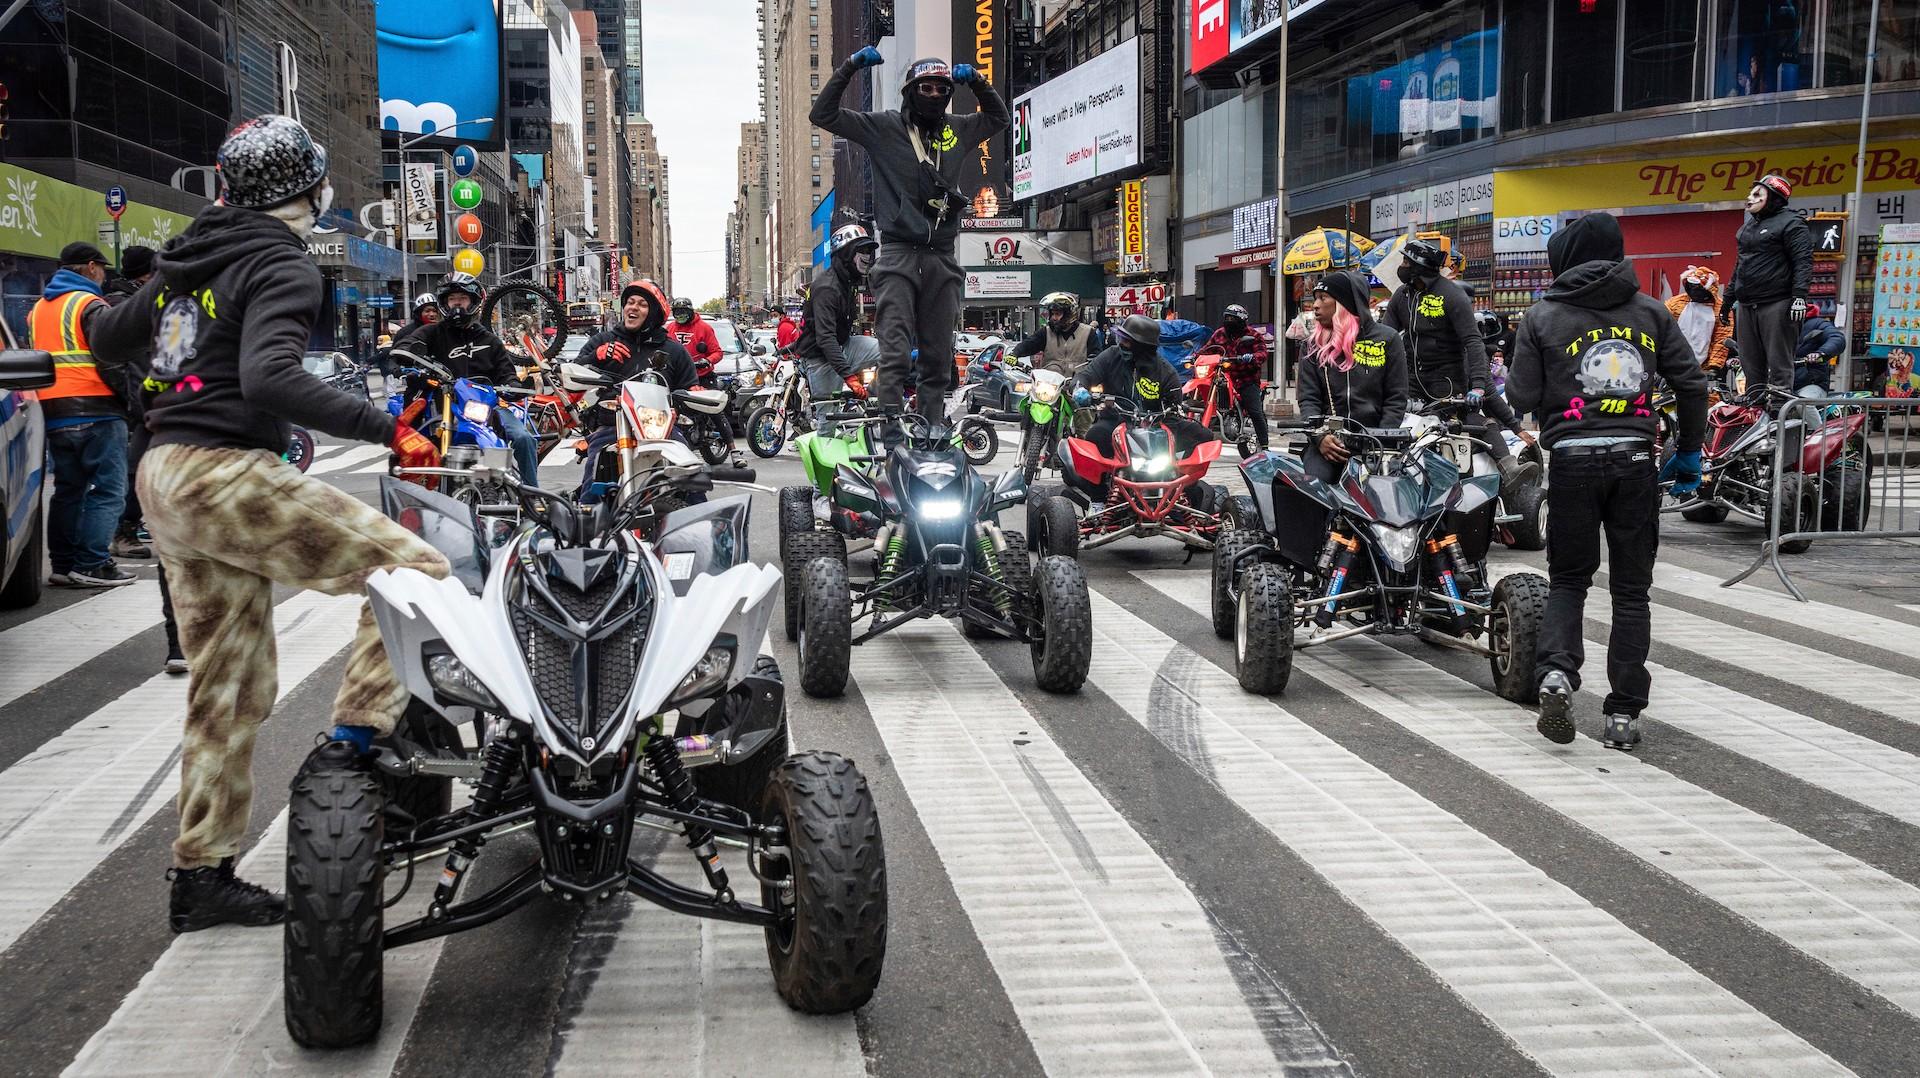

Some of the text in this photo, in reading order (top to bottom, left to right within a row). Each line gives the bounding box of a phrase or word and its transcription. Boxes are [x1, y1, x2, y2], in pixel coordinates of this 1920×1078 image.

[1042, 83, 1125, 128] News with a New Perspective.
[456, 156, 466, 166] m
[1014, 155, 1032, 173] BLACK
[1066, 146, 1093, 165] Listen Now
[1638, 164, 1707, 202] The
[460, 188, 472, 199] m
[1433, 190, 1454, 209] BAGS
[1461, 182, 1493, 203] BOLSAS
[1127, 183, 1140, 253] LUGGAGE
[1376, 203, 1394, 220] BAGS
[467, 223, 478, 233] m
[1499, 219, 1552, 237] BAGS
[461, 258, 474, 268] m
[1253, 249, 1277, 260] CHOCOLATE
[1126, 264, 1141, 273] NY
[1285, 259, 1329, 272] SABRETT
[1566, 326, 1656, 357] TTMB
[1600, 398, 1628, 414] 718
